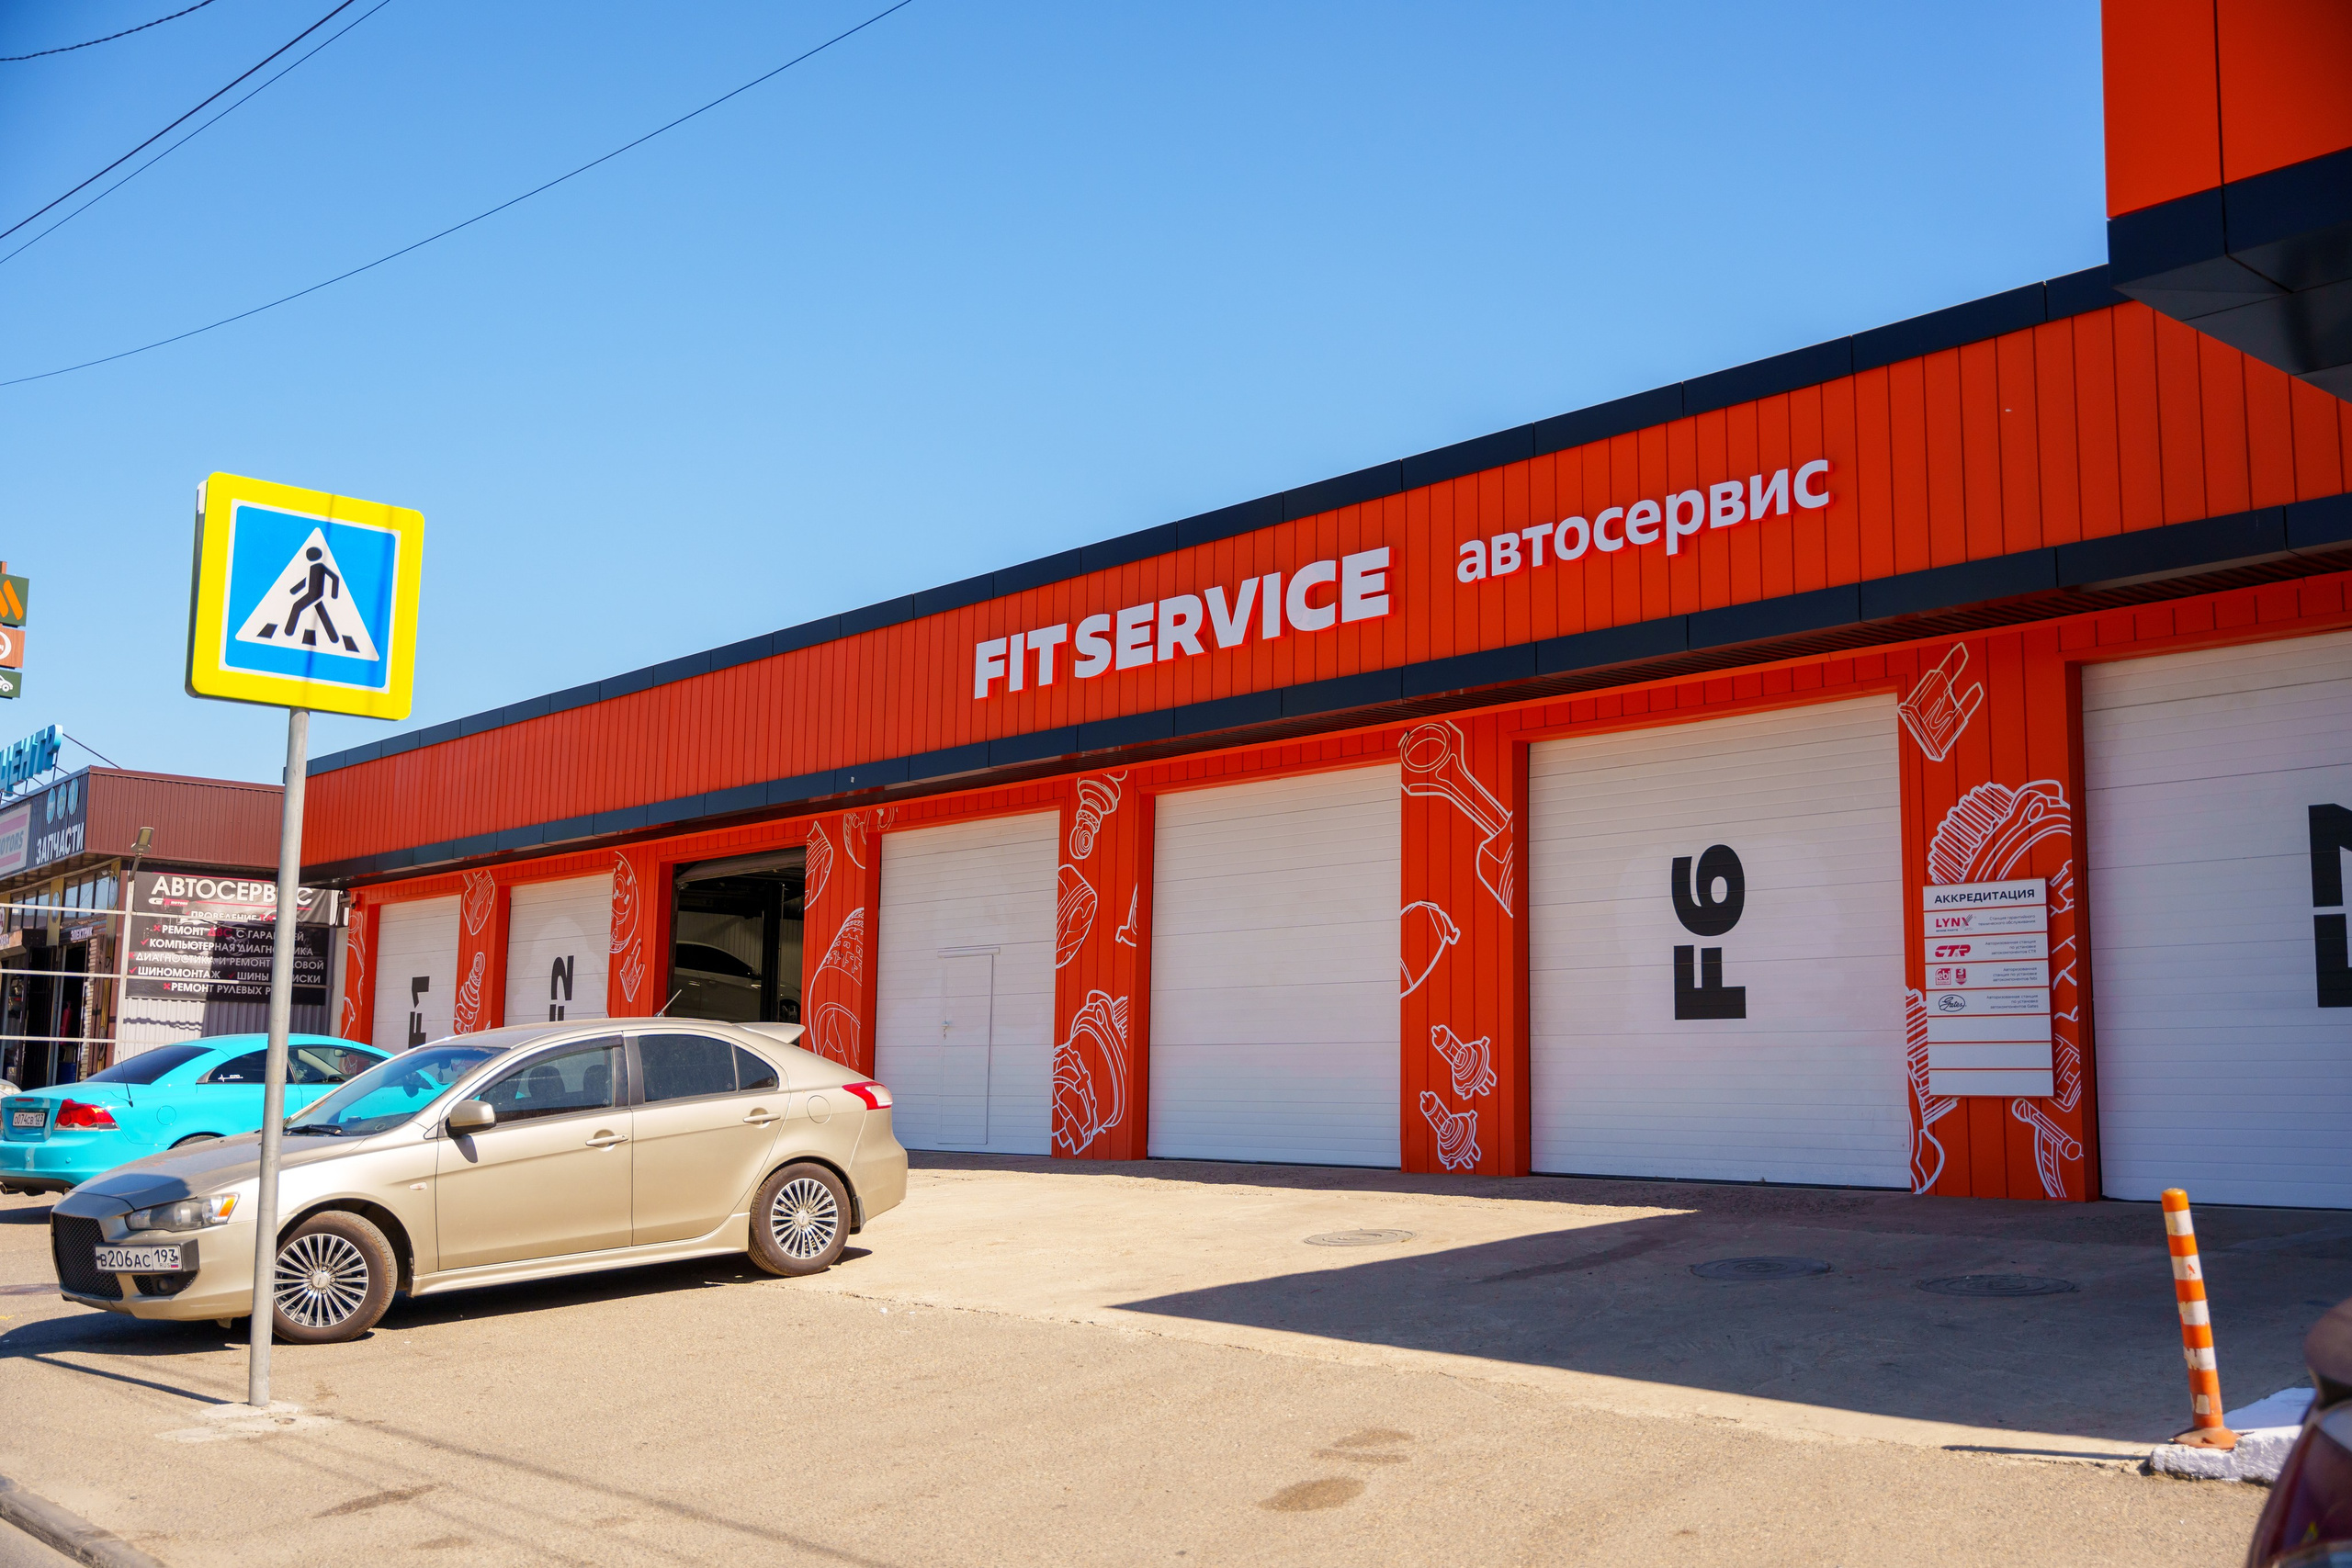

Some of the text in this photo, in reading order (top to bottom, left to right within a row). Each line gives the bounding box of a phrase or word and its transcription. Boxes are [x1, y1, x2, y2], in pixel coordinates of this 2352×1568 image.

[1457, 460, 1829, 583] автосервис
[975, 547, 1391, 699] FIT SERVICE
[0, 830, 24, 855] OTORS
[36, 822, 85, 864] ЗАПЧАСТИ
[152, 876, 312, 906] АВТОСЕРВС
[1934, 889, 2035, 904] АККРЕДИТАЦИЯ
[1936, 914, 1973, 928] LYNX
[162, 925, 205, 935] РЕМОНТ
[247, 930, 304, 942] ГАРАЙ
[1671, 844, 1746, 1020] F6
[149, 938, 313, 955] КОМПЬЮТЕРНАЯ ДИАГНИКА
[136, 952, 216, 964] ДИАГНОСТИКА
[230, 958, 271, 967] РЕМОНТ
[292, 960, 324, 970] ОВОЙ
[138, 966, 321, 984] ШИНОМОНТАЖ ШИНЫ ИСКИ
[171, 982, 214, 992] РЕМОНТ
[217, 985, 263, 995] РУЛЕВЫХ
[100, 1249, 175, 1268] В206АС 193
